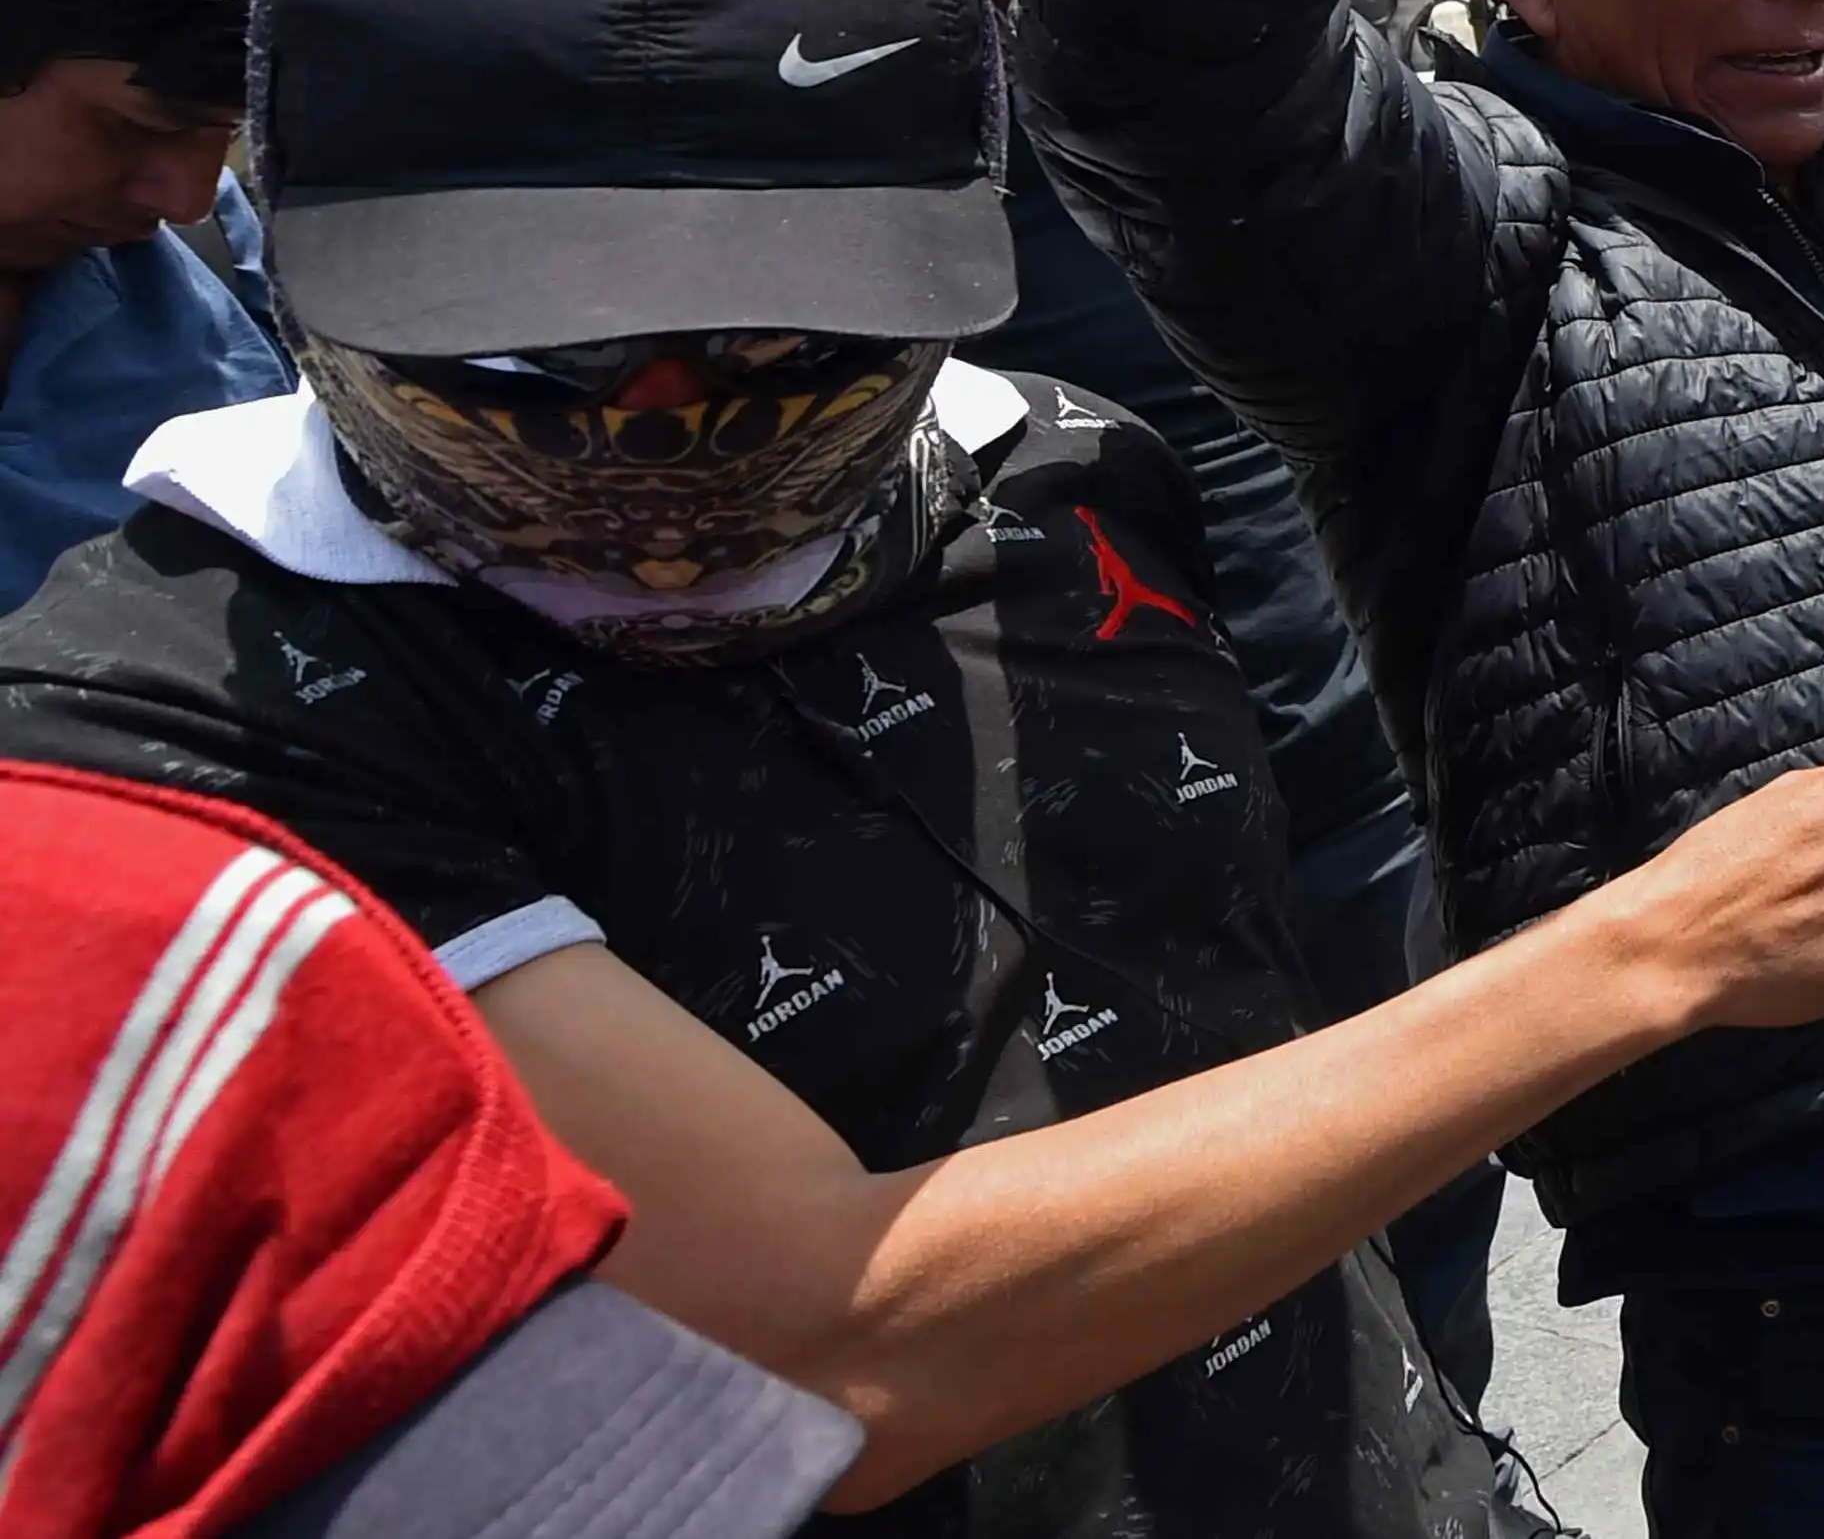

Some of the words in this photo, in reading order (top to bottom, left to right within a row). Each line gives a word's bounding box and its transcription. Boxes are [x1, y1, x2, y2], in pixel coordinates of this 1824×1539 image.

[858, 691, 936, 743] JORDAN
[1175, 772, 1239, 805] JORDAN
[746, 967, 845, 1043] JORDAN
[1037, 1007, 1119, 1062] JORDAN
[1205, 1318, 1272, 1378] JORDAN
